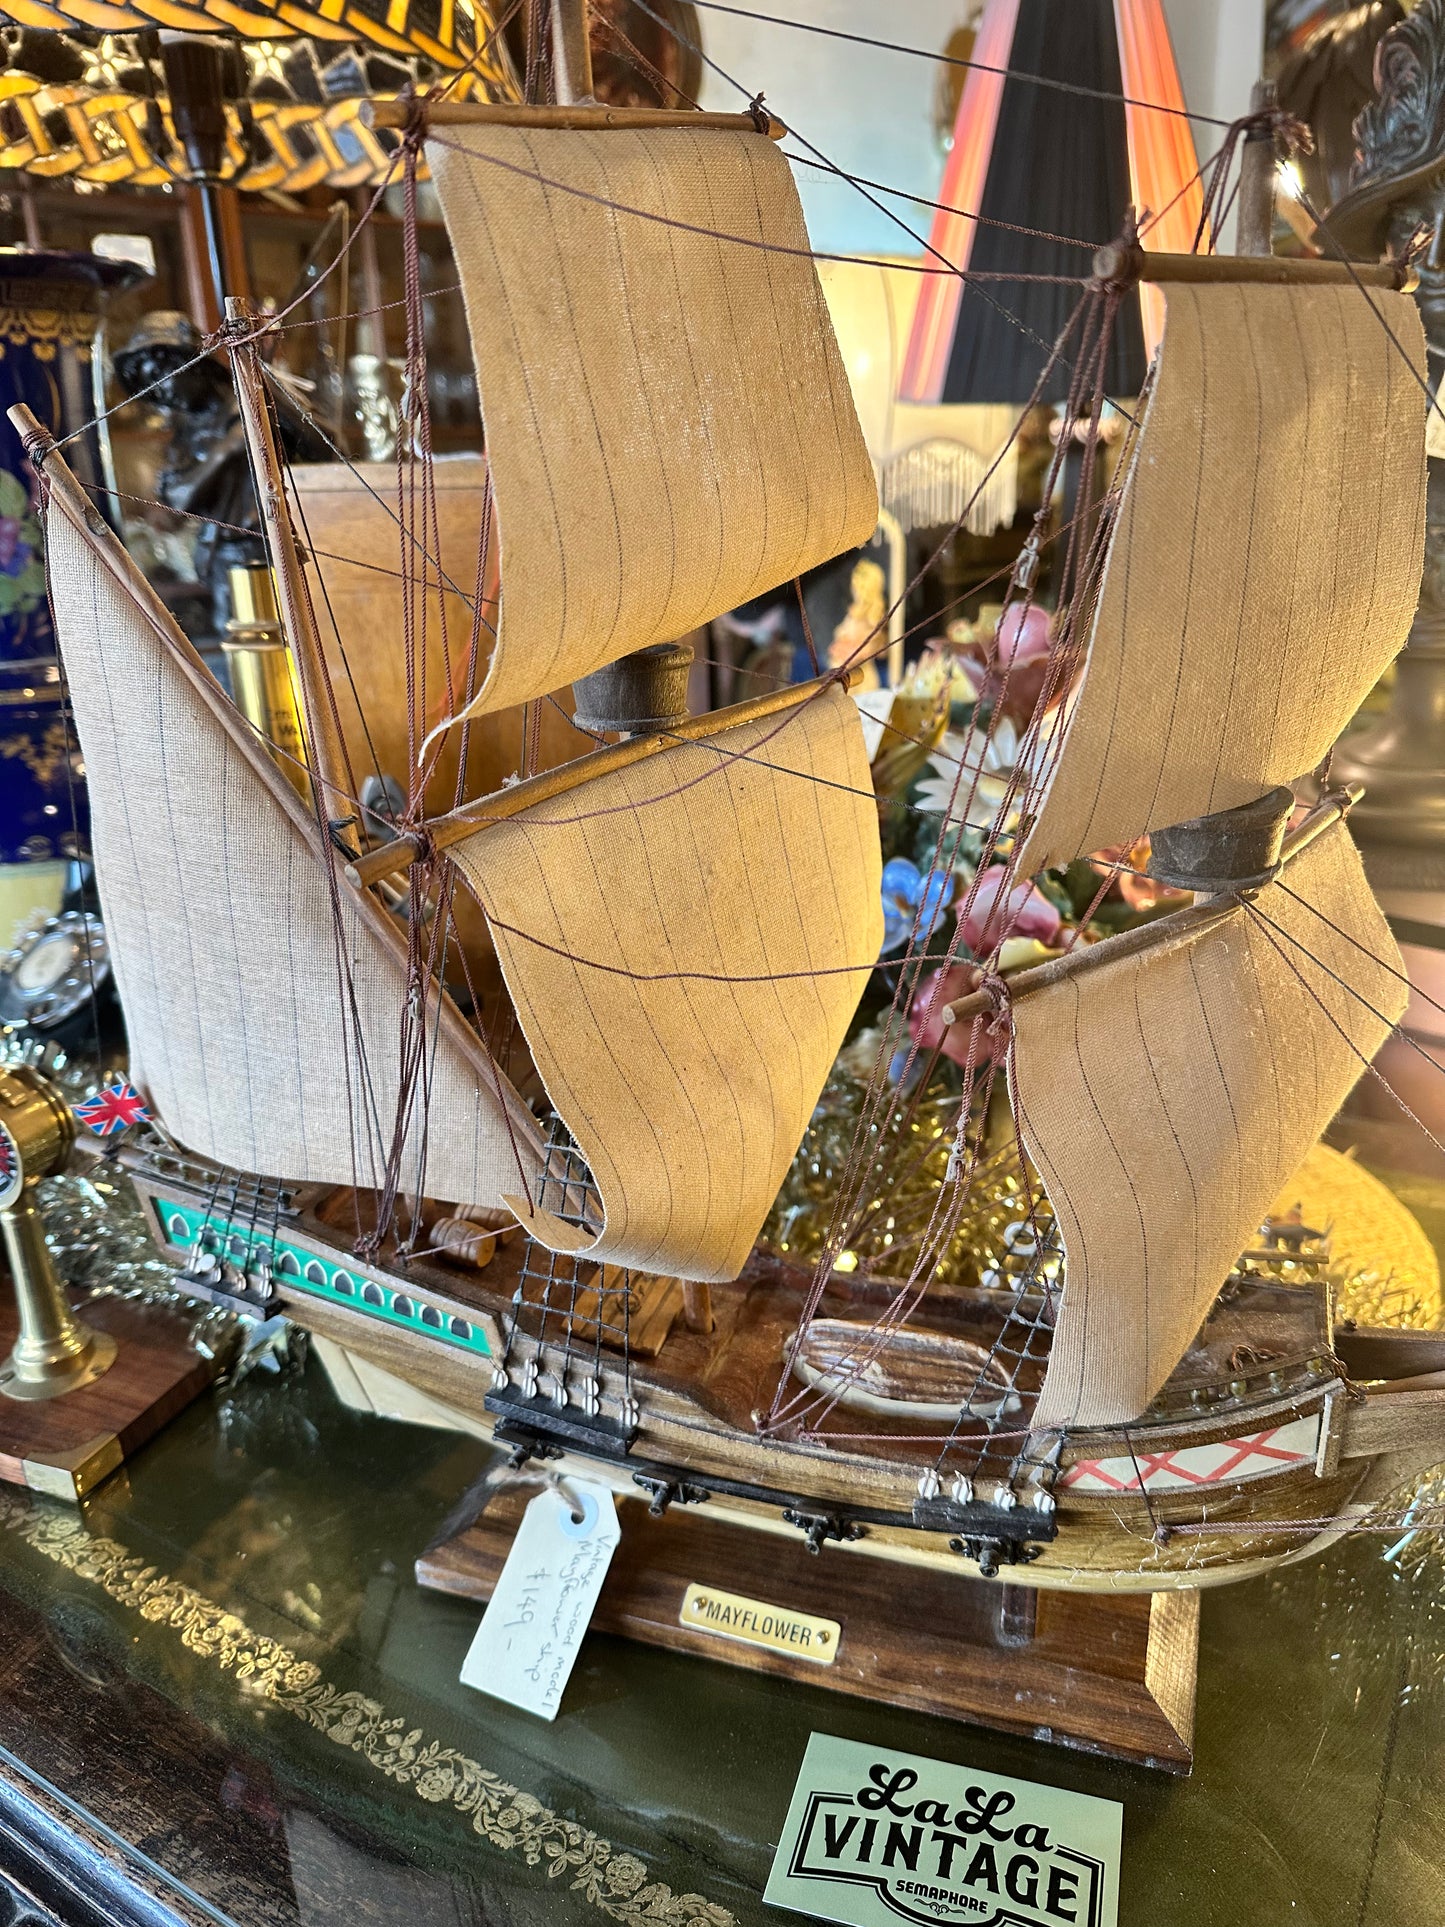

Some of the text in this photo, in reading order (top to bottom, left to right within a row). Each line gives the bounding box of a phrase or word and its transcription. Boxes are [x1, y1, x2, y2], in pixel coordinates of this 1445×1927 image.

[541, 1534, 613, 1708] Vintage wood model
[553, 1540, 593, 1638] Mayflower
[706, 1600, 812, 1647] MAYFLOWER
[823, 1813, 1080, 1924] VINTAGE
[895, 1879, 989, 1914] SEMAPHORE
